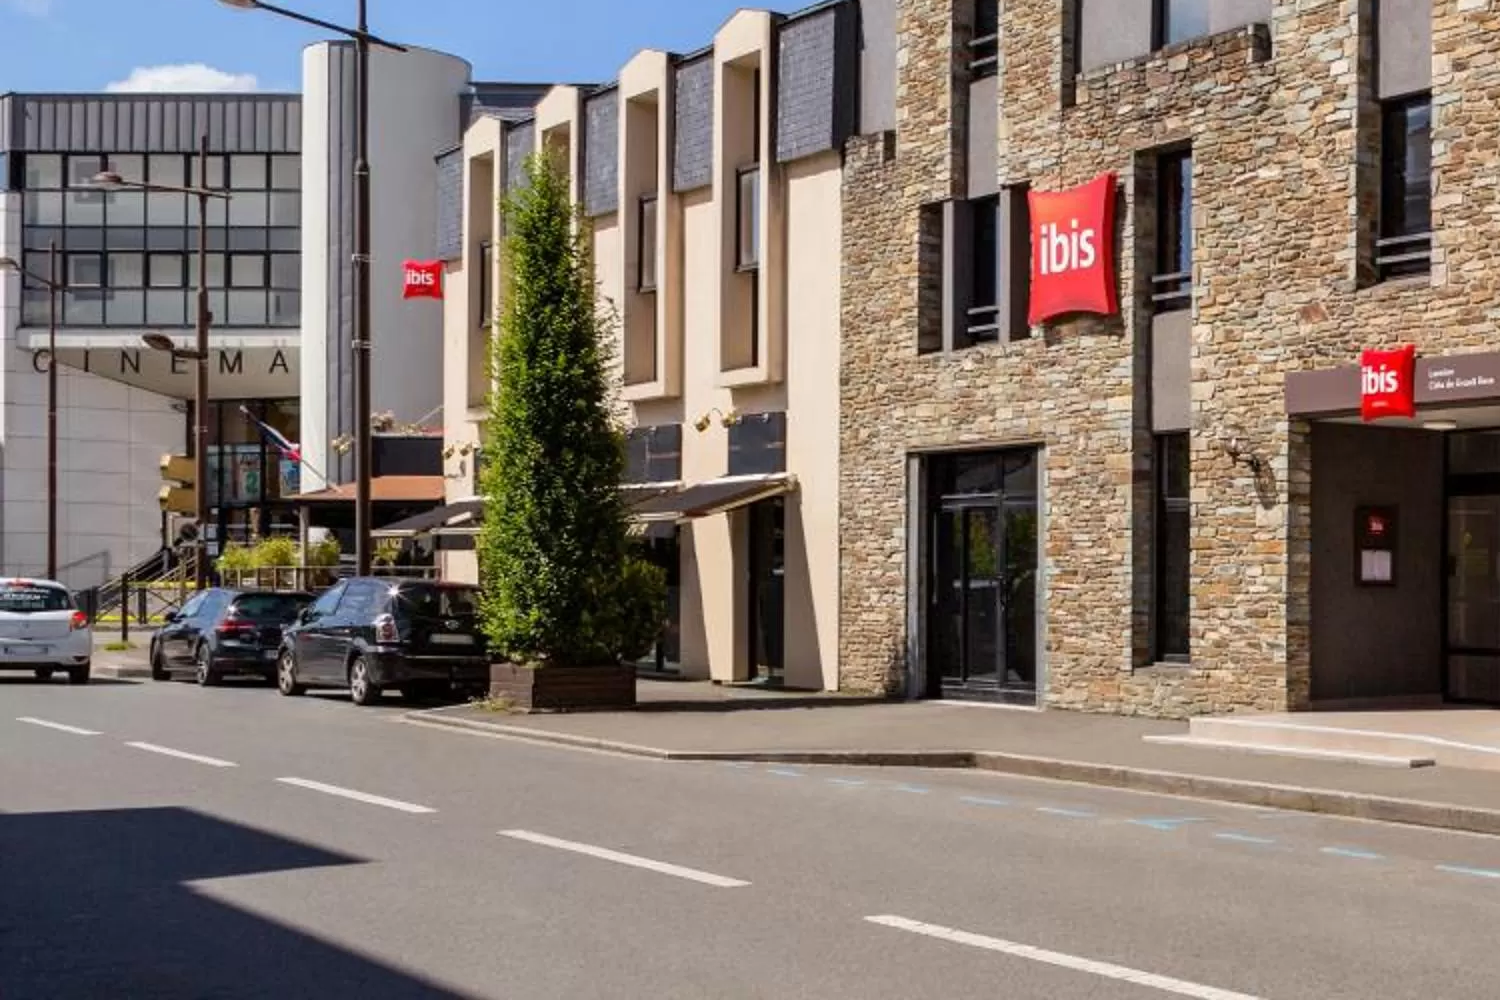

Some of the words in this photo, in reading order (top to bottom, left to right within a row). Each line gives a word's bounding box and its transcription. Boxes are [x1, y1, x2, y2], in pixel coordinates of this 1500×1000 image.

[1040, 219, 1095, 275] ibis
[406, 269, 434, 285] ibis
[1362, 364, 1399, 394] ibis
